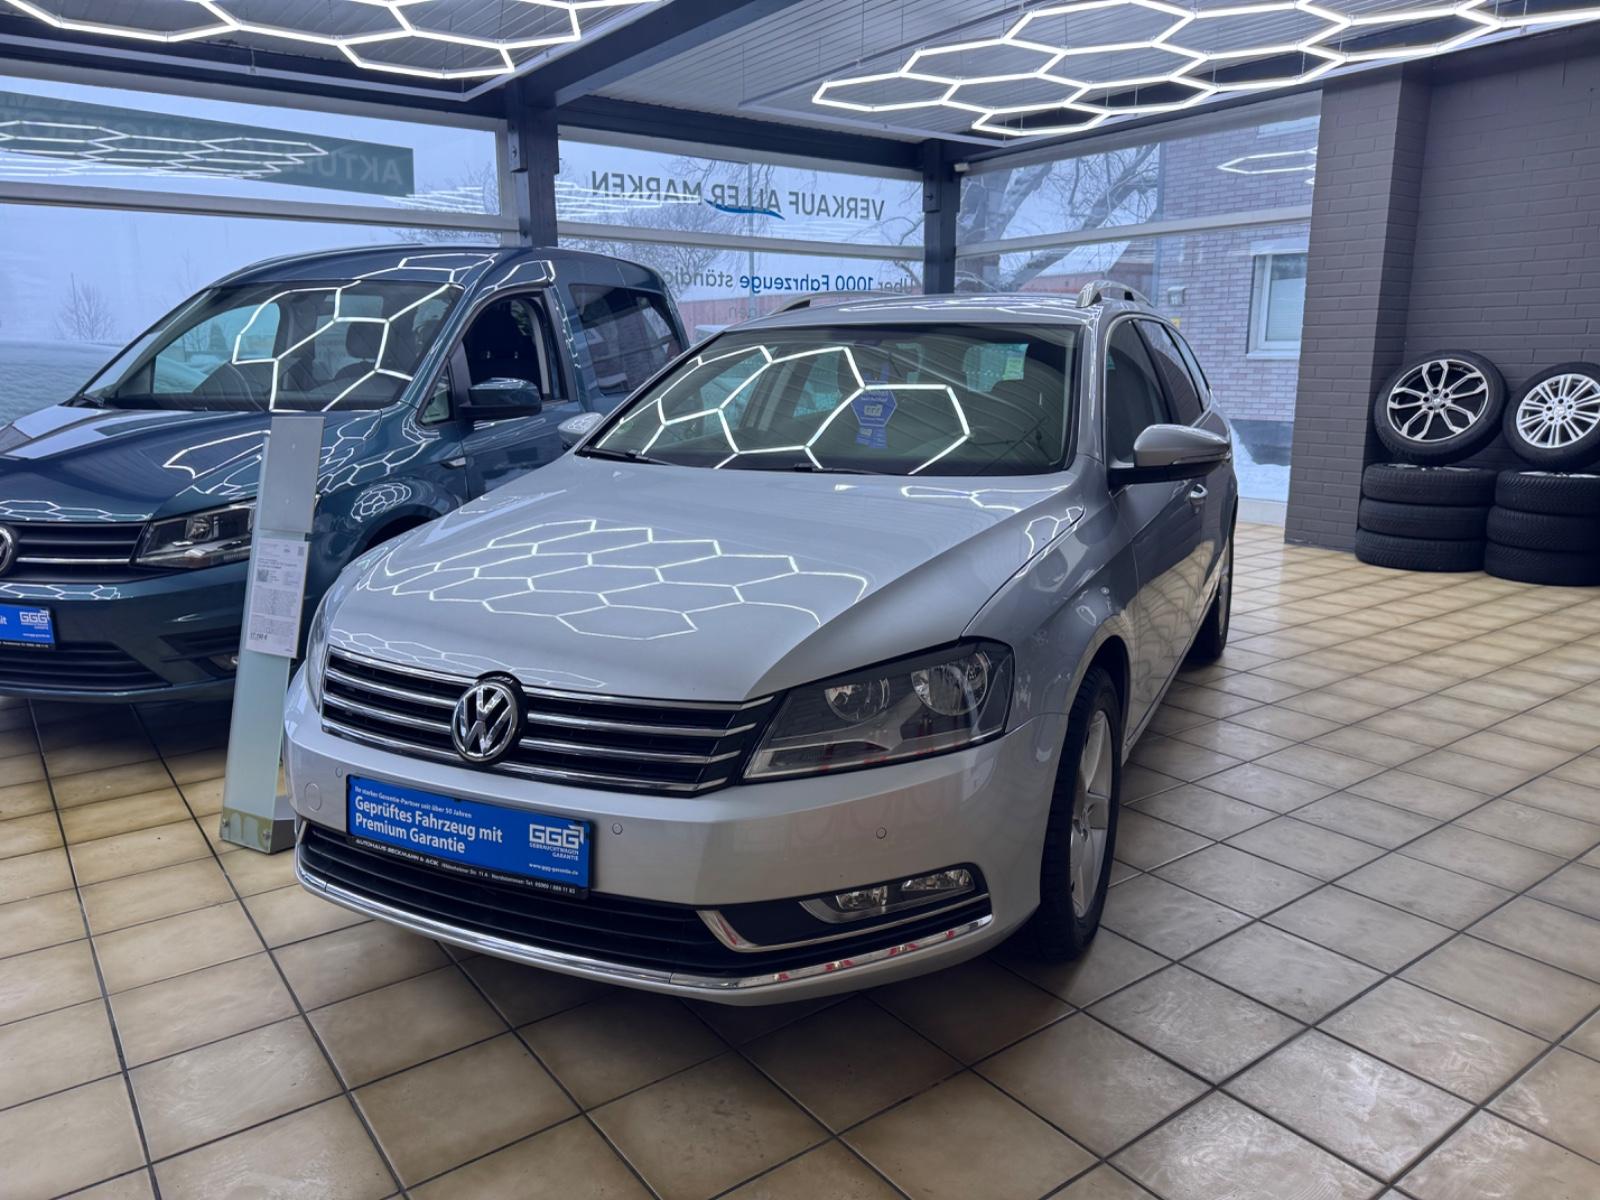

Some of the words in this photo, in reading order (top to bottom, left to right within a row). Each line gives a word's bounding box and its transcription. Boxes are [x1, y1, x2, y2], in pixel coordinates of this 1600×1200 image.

[355, 796, 412, 823] Geprüftes
[415, 811, 476, 841] Fahrzeug
[479, 825, 503, 844] mit
[355, 813, 407, 840] Premium
[410, 828, 466, 854] Garantie
[529, 823, 584, 849] GGG
